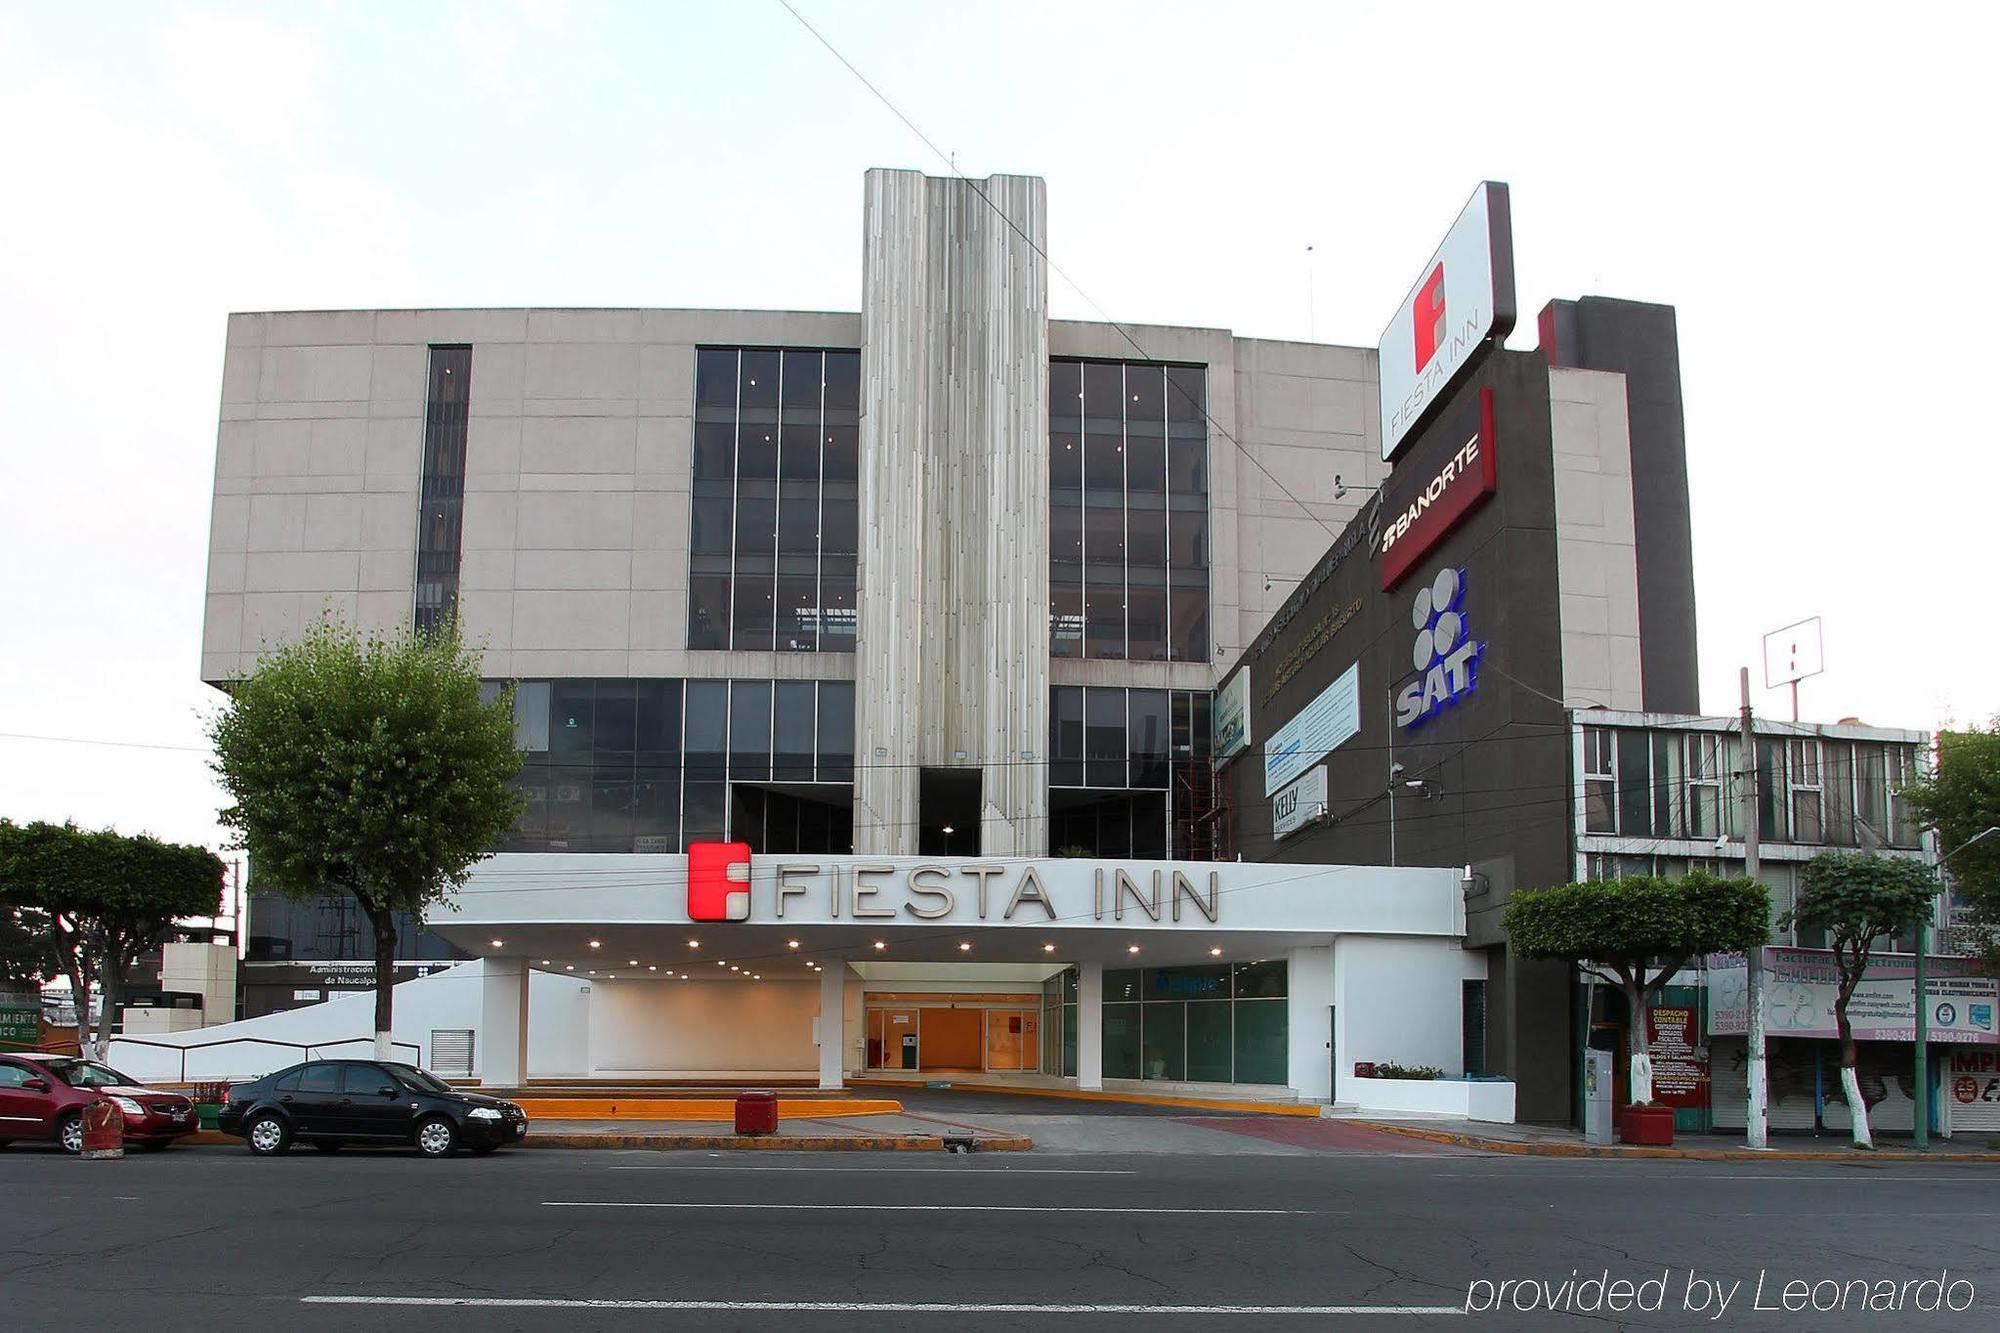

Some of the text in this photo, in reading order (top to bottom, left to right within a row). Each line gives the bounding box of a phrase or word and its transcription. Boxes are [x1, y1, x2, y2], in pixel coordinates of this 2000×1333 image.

[1391, 309, 1479, 437] FIESTA INN
[1396, 433, 1479, 539] BANORTE
[1396, 640, 1478, 728] SAT
[1274, 786, 1299, 823] KELLY
[775, 864, 1219, 923] FIESTA INN
[309, 964, 374, 974] Administración
[324, 976, 377, 986] de Naucalpa
[1653, 1009, 1689, 1017] DESPACHO
[1951, 1051, 2000, 1073] IMP
